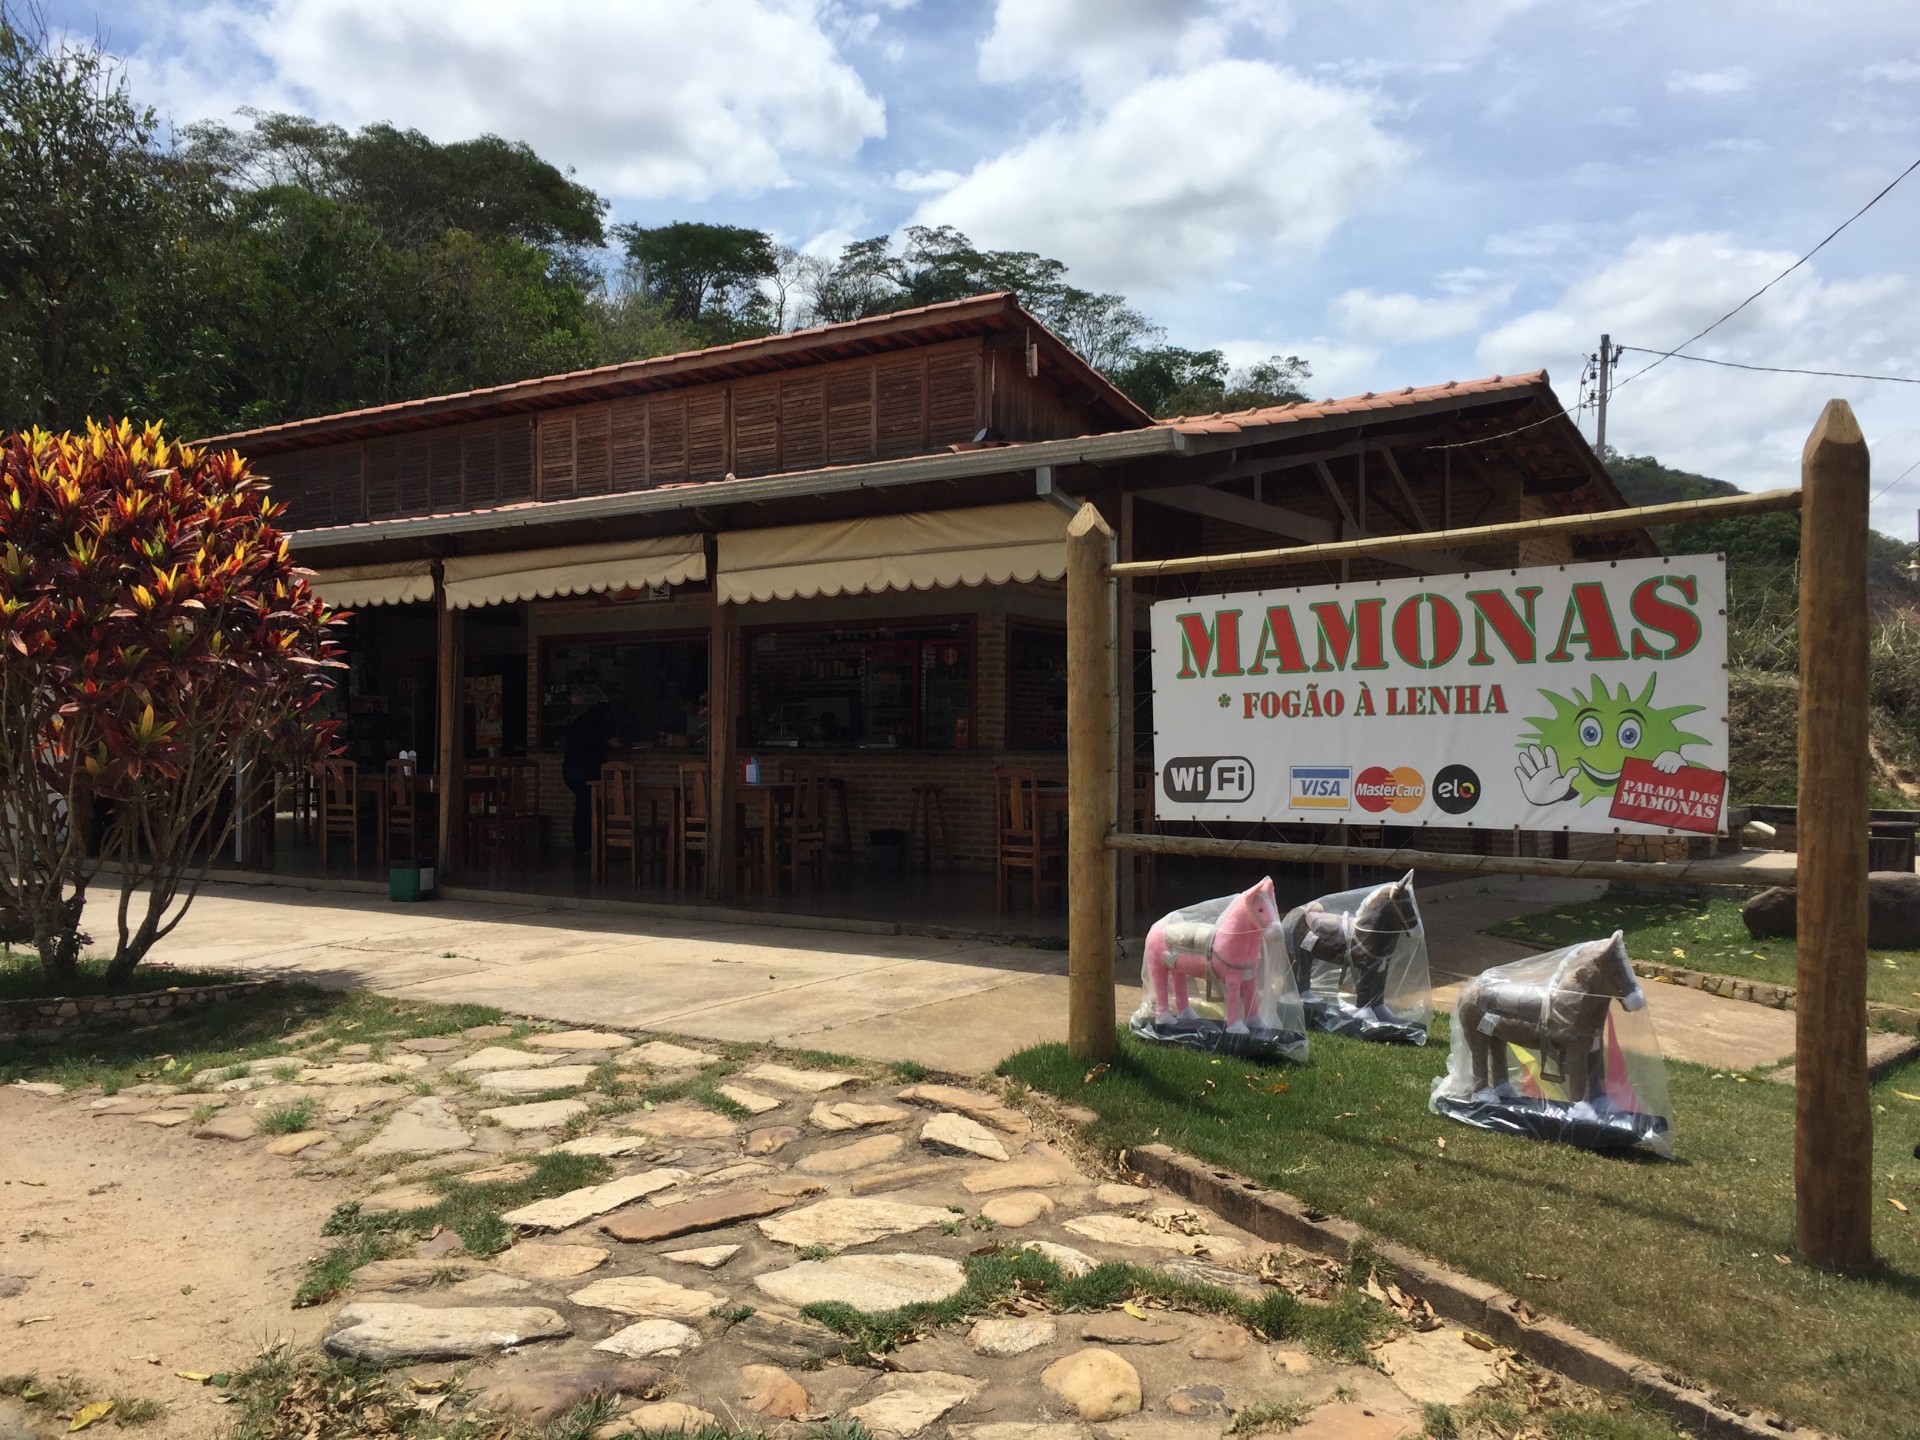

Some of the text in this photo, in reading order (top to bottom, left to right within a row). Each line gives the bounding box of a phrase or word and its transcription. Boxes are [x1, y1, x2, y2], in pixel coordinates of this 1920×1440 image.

[1175, 575, 1703, 679] MAMONAS
[1242, 681, 1510, 719] FOGÃO À LENHA
[1300, 780, 1342, 797] VISA
[1355, 782, 1425, 798] MasterCard
[1438, 780, 1475, 799] elo
[1623, 780, 1720, 805] PARADA DAS
[1619, 791, 1717, 819] MAMONAS
